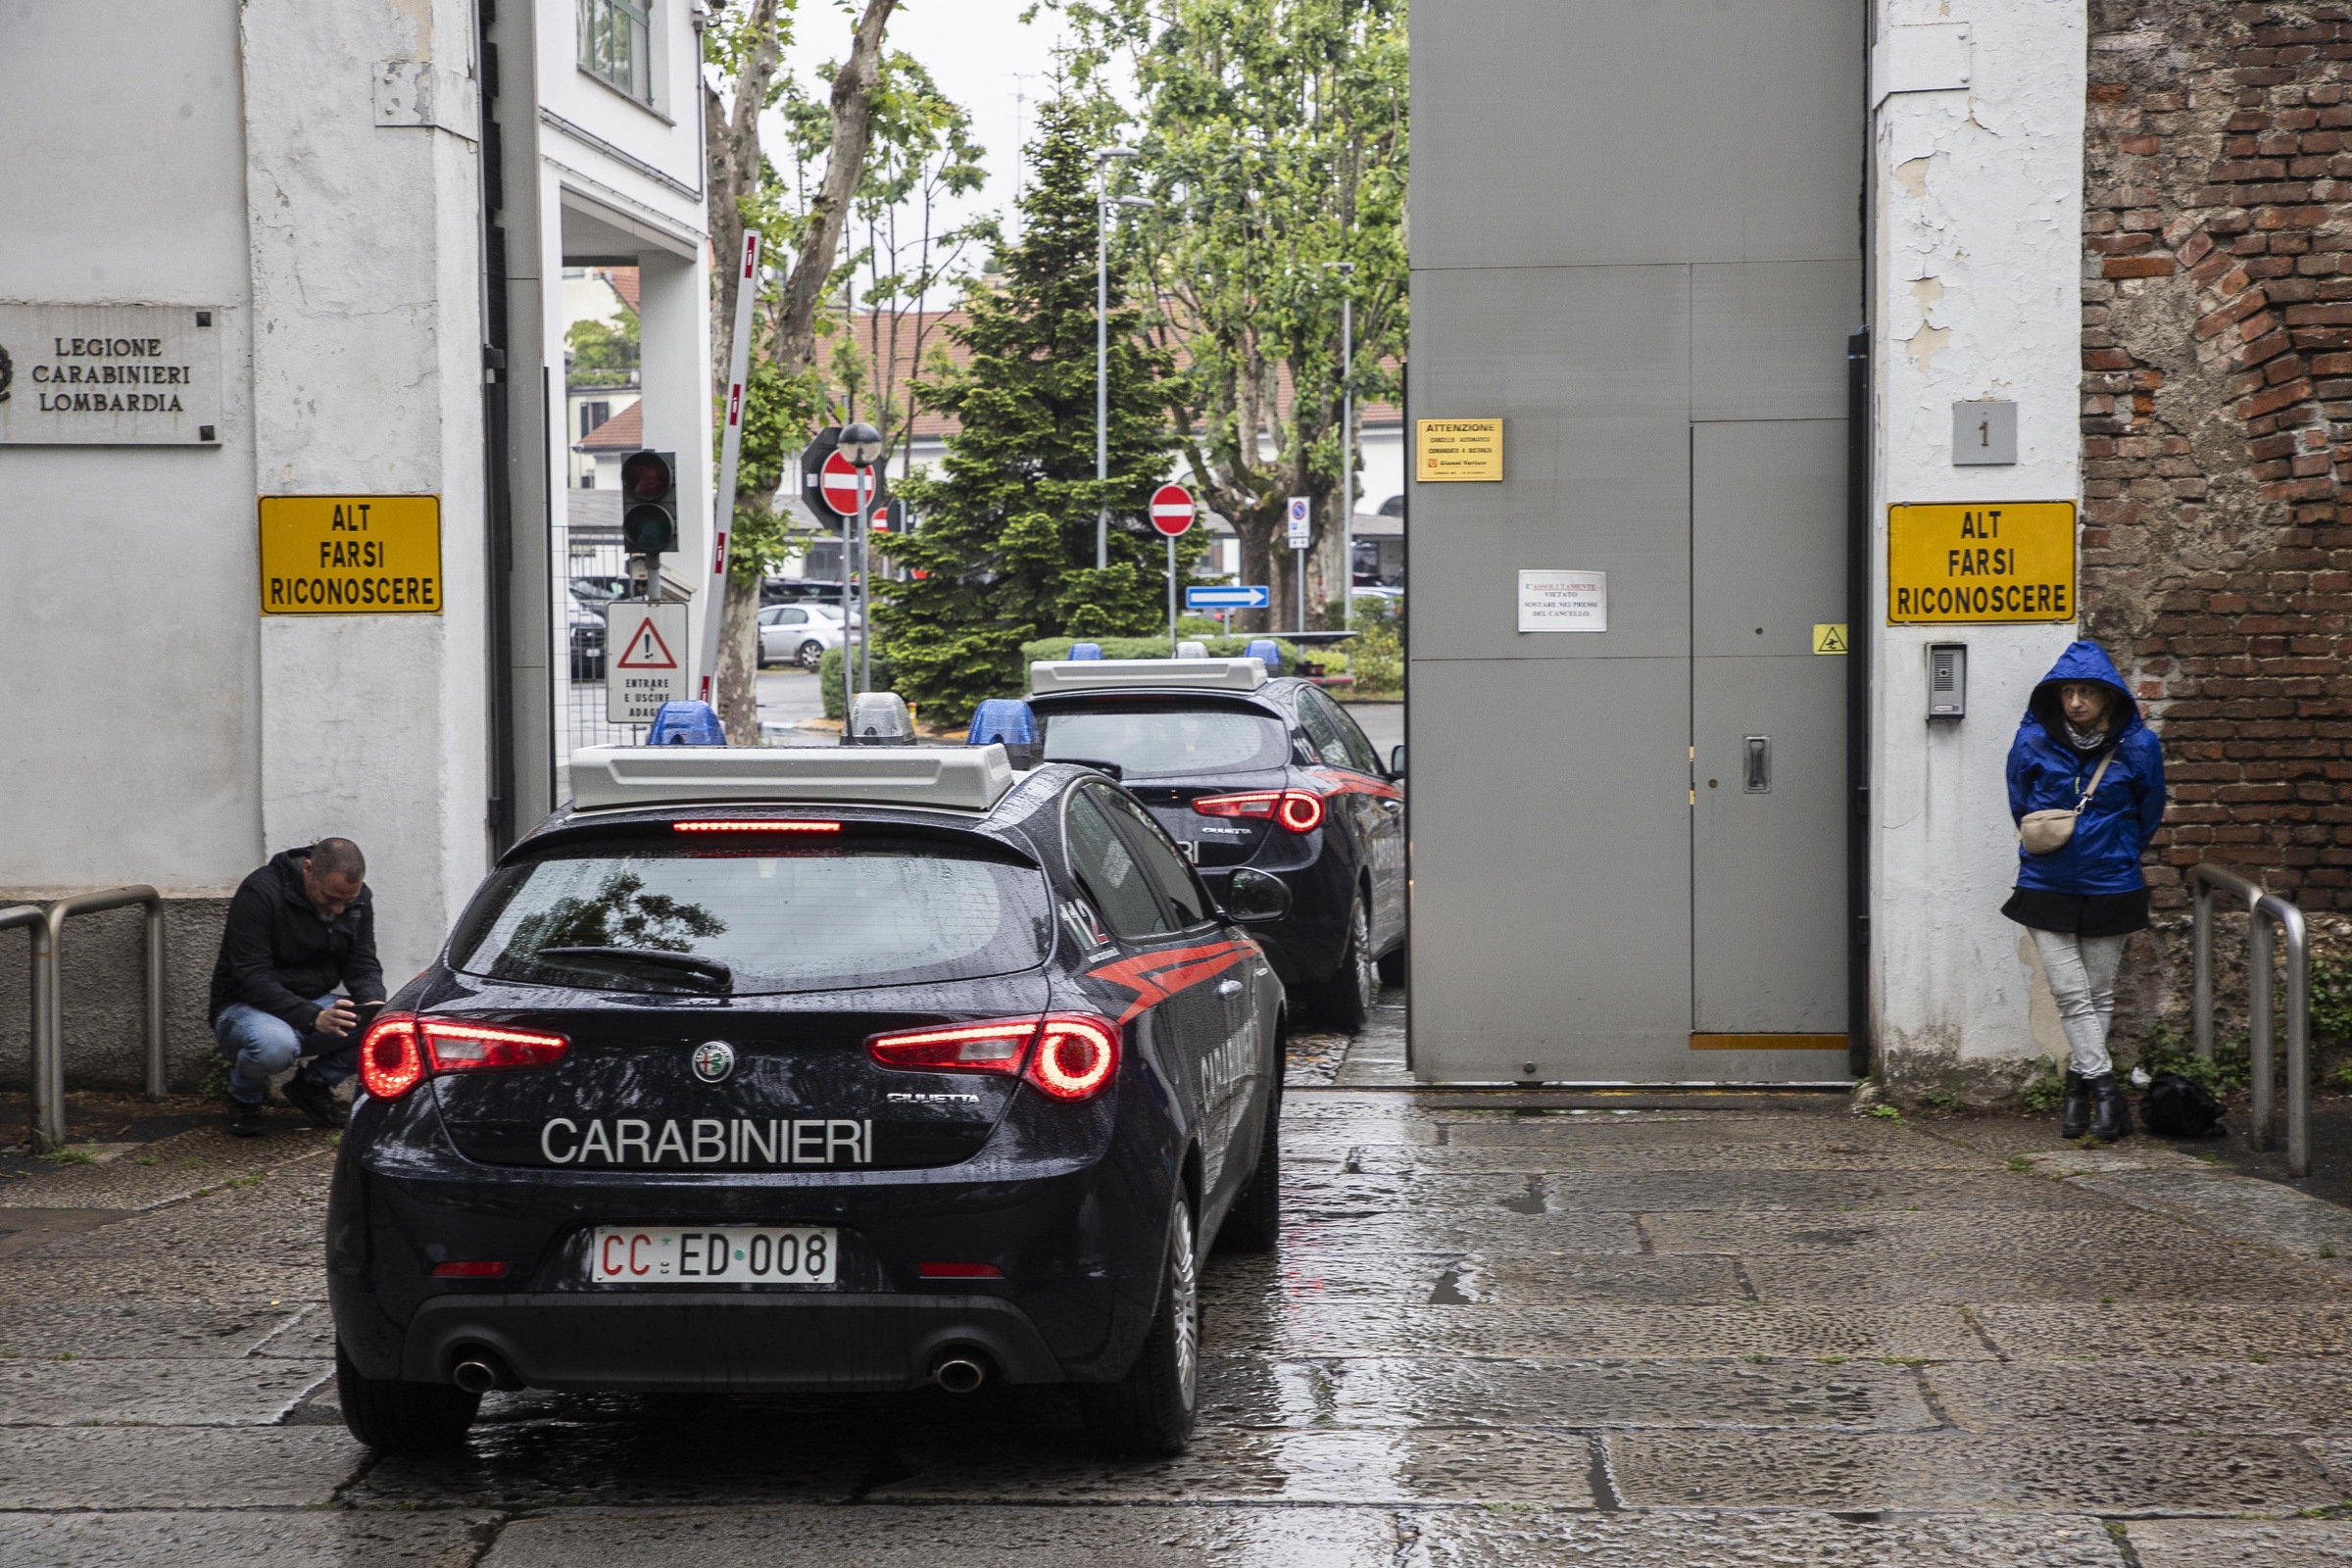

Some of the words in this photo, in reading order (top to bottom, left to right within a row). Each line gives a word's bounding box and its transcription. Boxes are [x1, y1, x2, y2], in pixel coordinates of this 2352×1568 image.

[55, 338, 163, 357] LEGIONE
[32, 366, 191, 384] CARABINIERI
[39, 393, 183, 412] LOMBARDIA
[1426, 423, 1495, 432] ATTENZIONE
[331, 504, 370, 531] ALT
[1961, 511, 2001, 539] ALT
[319, 541, 384, 568] FARSI
[1948, 548, 2014, 576] FARSI
[270, 577, 434, 605] RICONOSCERE
[1897, 584, 2067, 614] RICONOSCERE
[625, 678, 669, 688] ENTRARE
[624, 693, 630, 702] E
[635, 693, 669, 702] USCIRE
[1058, 898, 1109, 951] 112
[887, 1093, 981, 1104] GIULIETTA
[541, 1117, 872, 1164] CARABINIERI
[602, 1234, 652, 1276] CC
[679, 1233, 729, 1276] ED
[750, 1233, 827, 1276] 008
